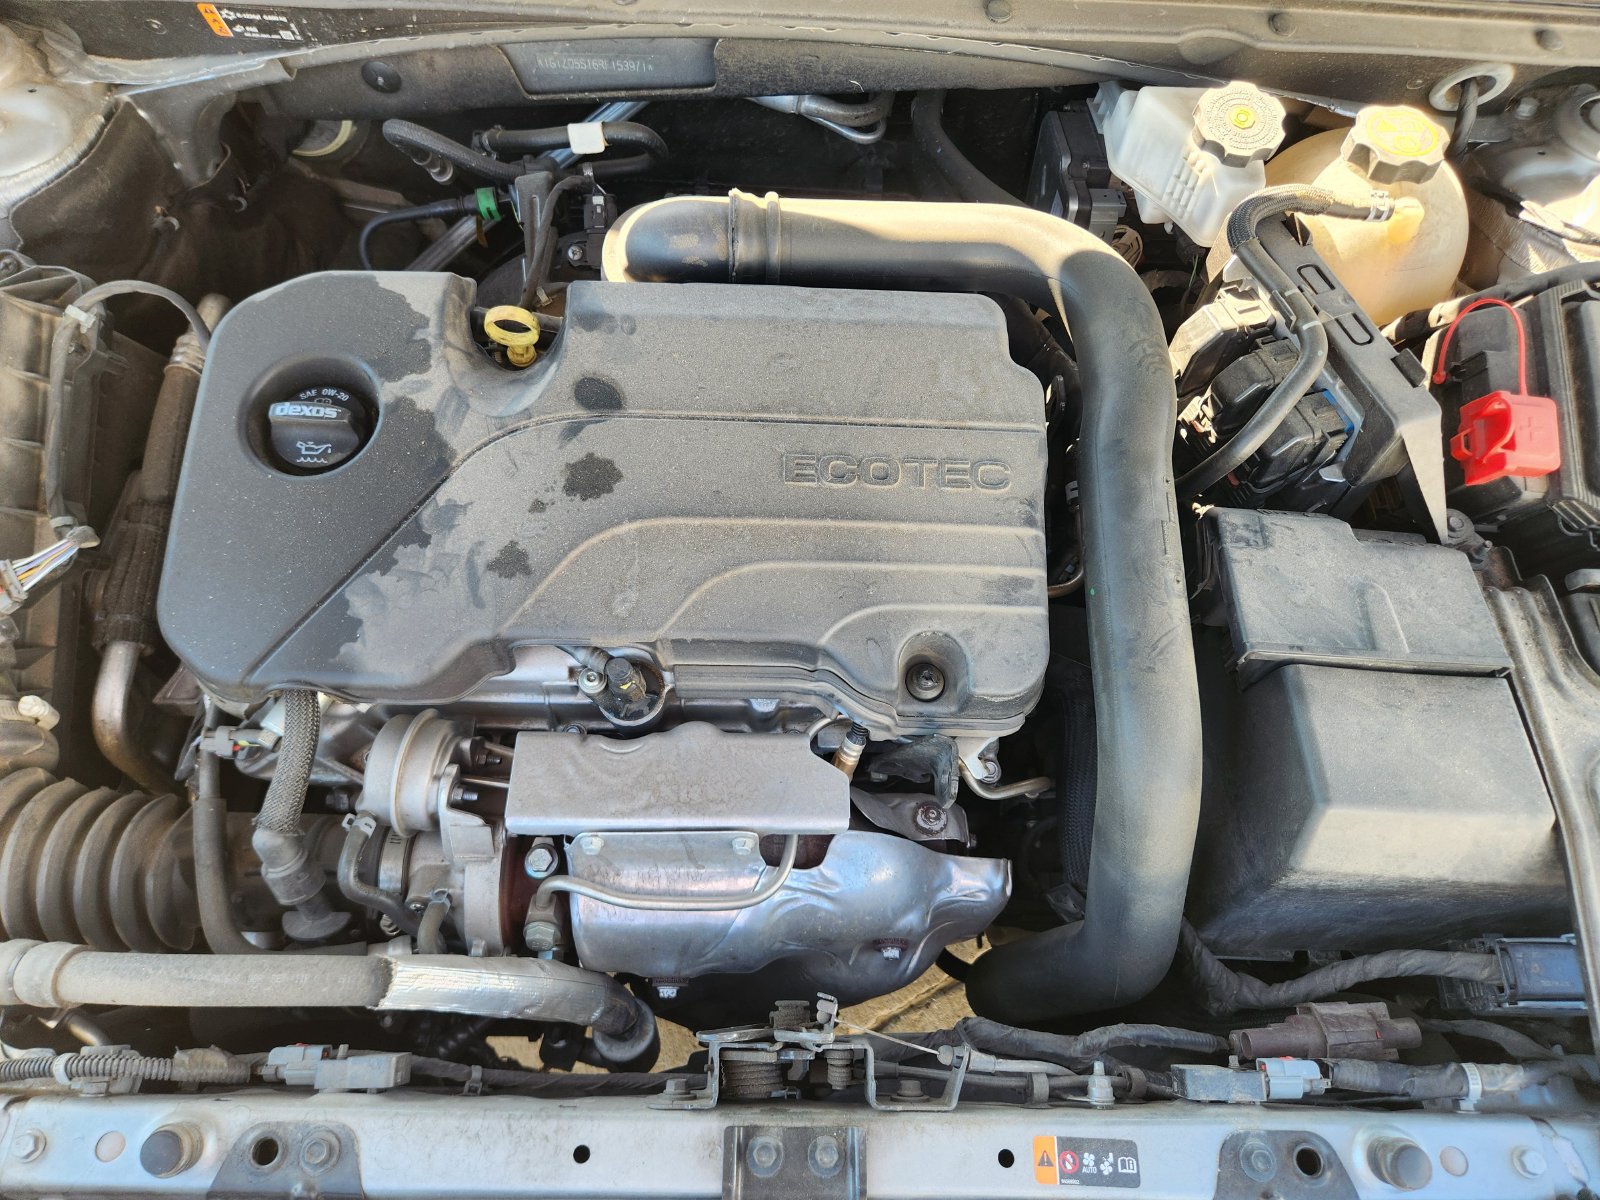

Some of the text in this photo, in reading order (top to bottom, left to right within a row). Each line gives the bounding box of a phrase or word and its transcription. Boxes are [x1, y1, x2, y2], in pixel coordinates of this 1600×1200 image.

[299, 388, 350, 402] SAE 0W-20
[275, 402, 338, 419] dexos
[783, 454, 1012, 492] ECOTEC
[1082, 1166, 1097, 1174] AUTO
